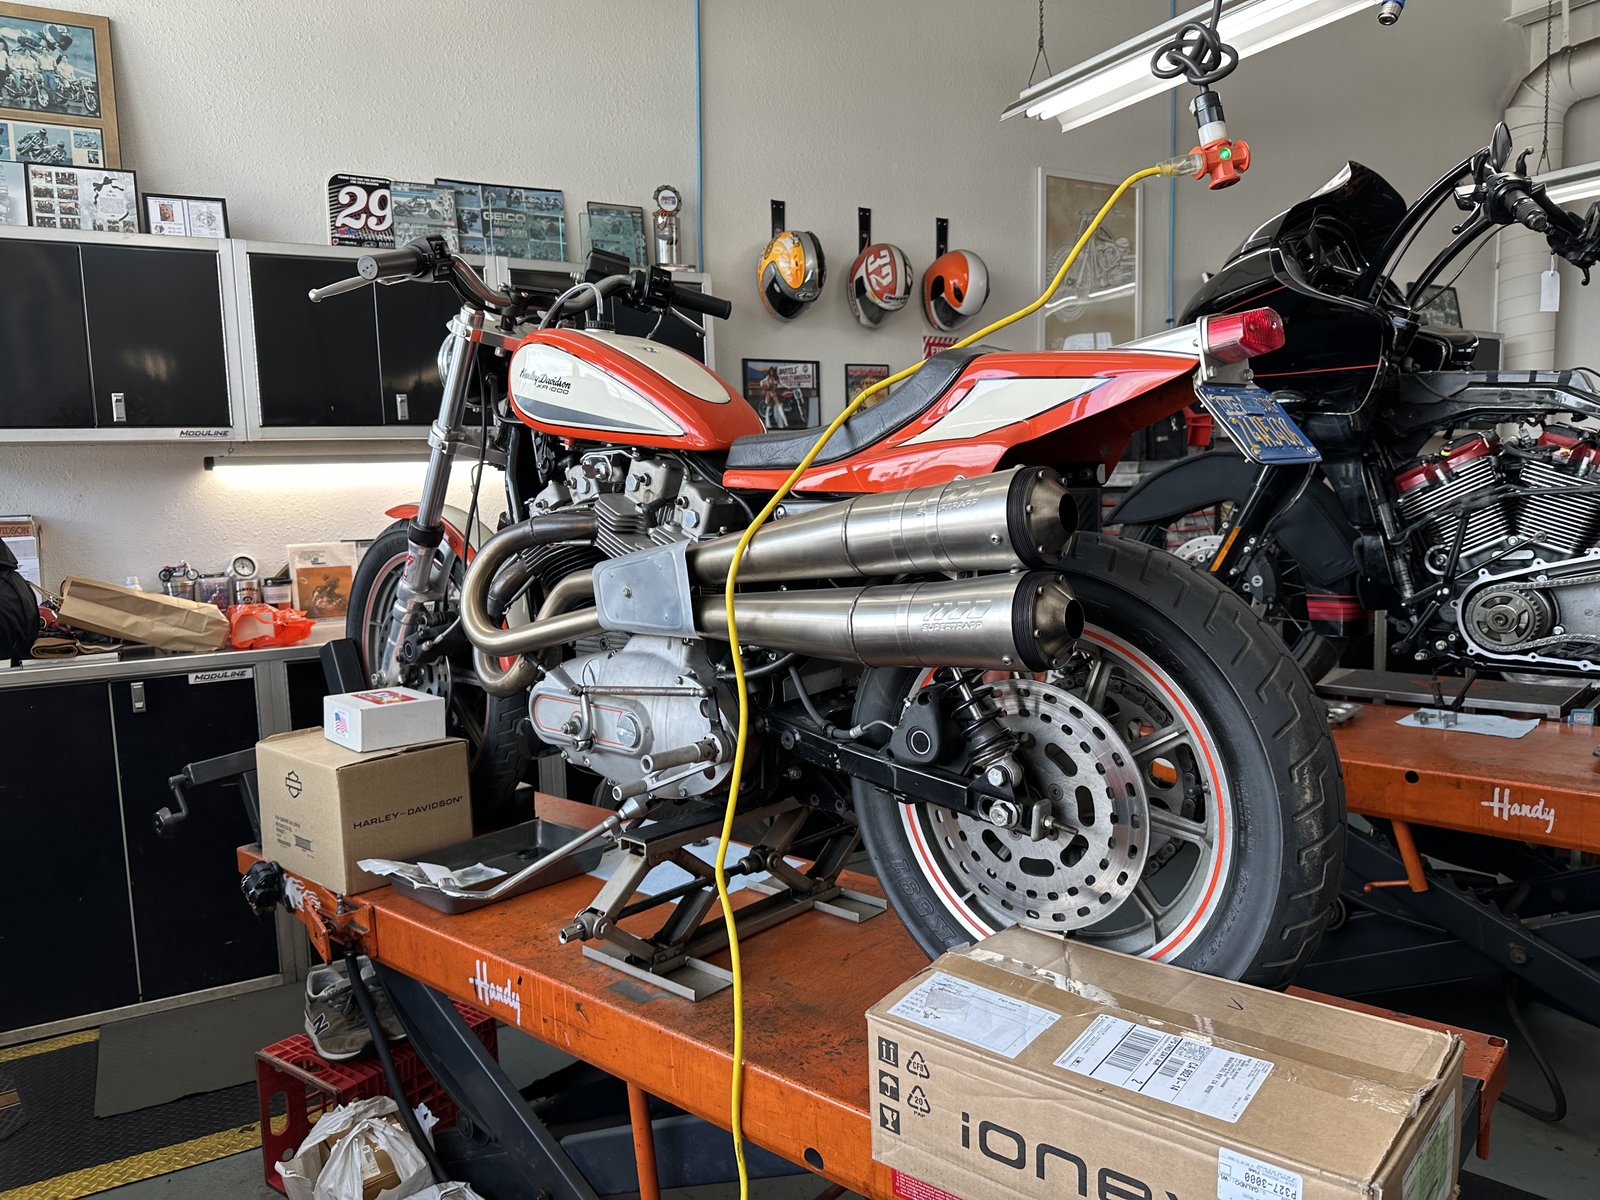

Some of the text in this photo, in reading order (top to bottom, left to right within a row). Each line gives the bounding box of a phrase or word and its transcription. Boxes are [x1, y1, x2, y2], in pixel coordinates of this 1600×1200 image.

[334, 185, 394, 231] 29
[482, 211, 526, 222] GEICO
[867, 249, 893, 291] 32
[0, 526, 30, 534] IDSON
[922, 620, 983, 632] SUPERTRAPP
[194, 670, 247, 680] MODULINE
[1480, 786, 1556, 834] Handy
[468, 959, 520, 1026] Handy
[312, 1012, 330, 1036] N
[912, 1061, 924, 1072] CFB
[914, 1096, 923, 1106] 20
[961, 1111, 1179, 1200] ione
[1244, 1172, 1297, 1200] P327-3000
